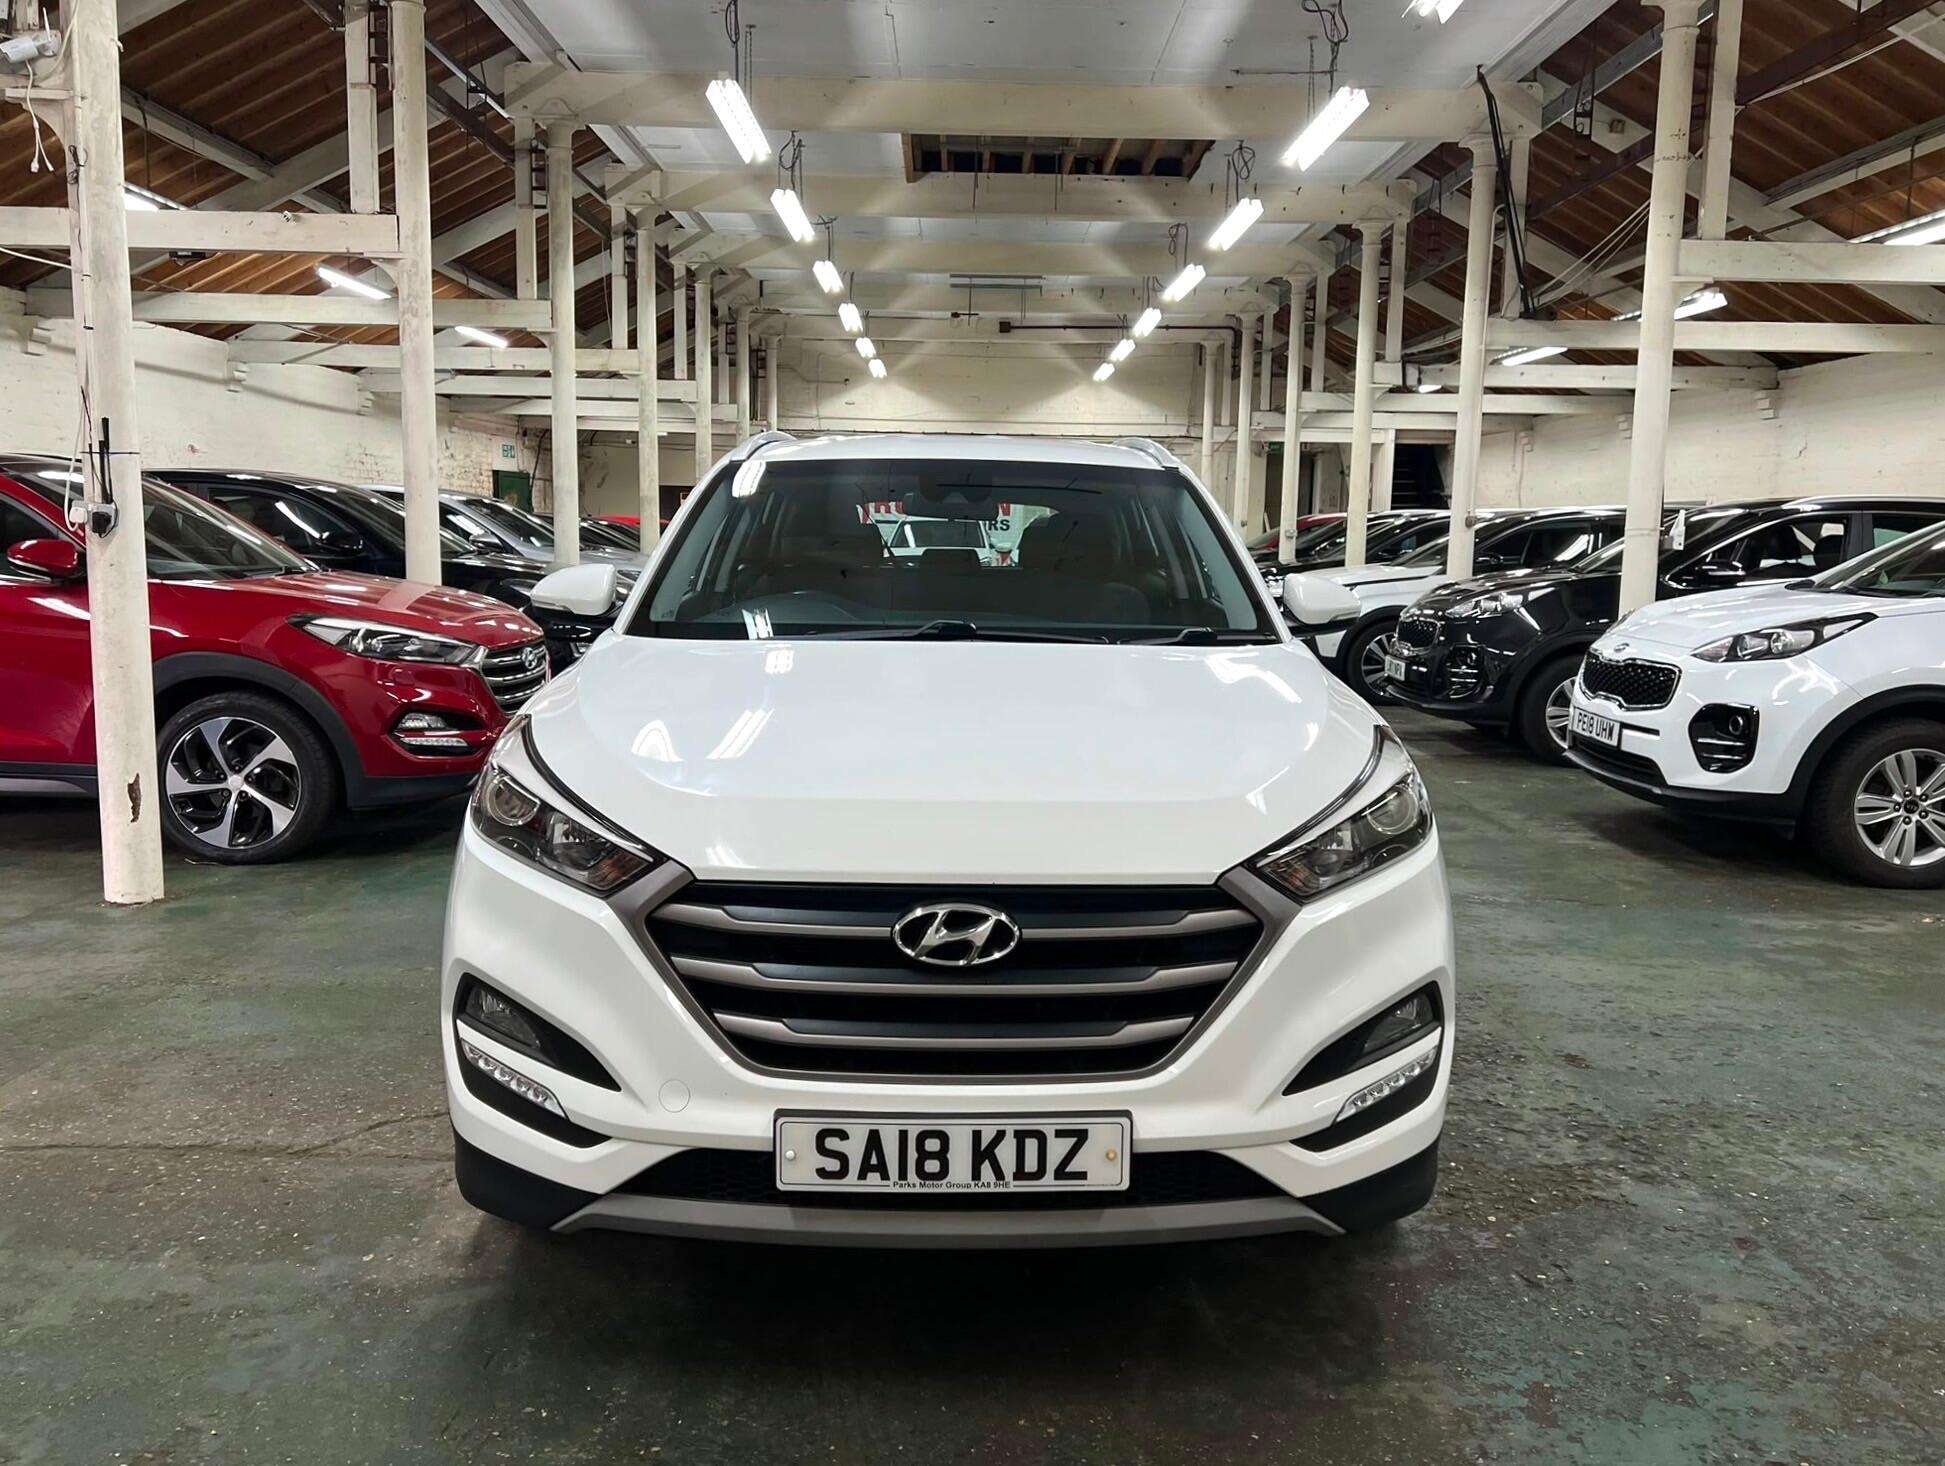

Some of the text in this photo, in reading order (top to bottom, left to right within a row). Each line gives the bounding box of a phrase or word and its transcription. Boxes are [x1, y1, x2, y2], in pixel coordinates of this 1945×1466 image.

[815, 1128, 1089, 1181] SA18 KDZ
[893, 1181, 1010, 1190] Parks Motor Group KA8 9HE
